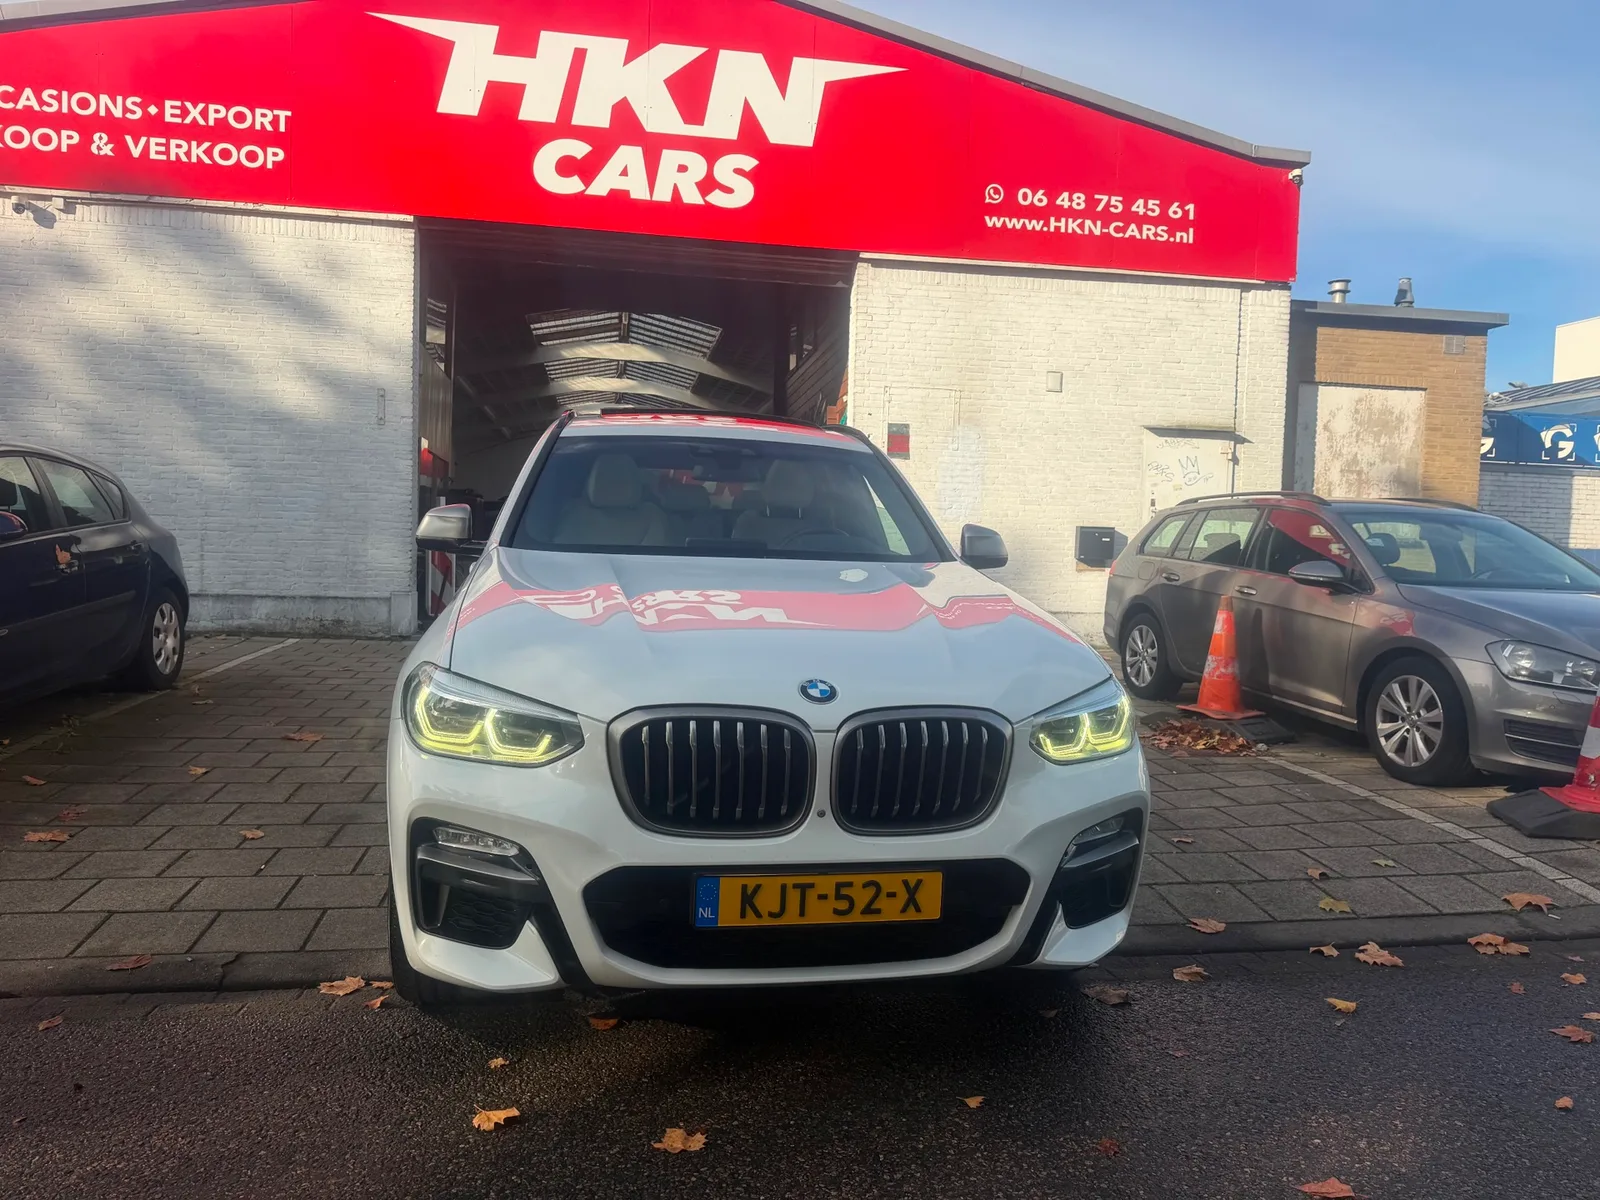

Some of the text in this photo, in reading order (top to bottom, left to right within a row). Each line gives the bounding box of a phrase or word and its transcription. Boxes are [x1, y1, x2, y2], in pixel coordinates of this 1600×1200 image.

[364, 11, 909, 147] HKN
[164, 99, 292, 132] EXPORT
[0, 124, 285, 169] OOP & VERKOOP
[532, 138, 760, 209] CARS
[1017, 187, 1195, 220] 06 48 75 45 61
[984, 215, 1194, 244] www.HKN-CARS.nl
[698, 907, 716, 919] NL
[739, 878, 924, 920] KJT-52-X
